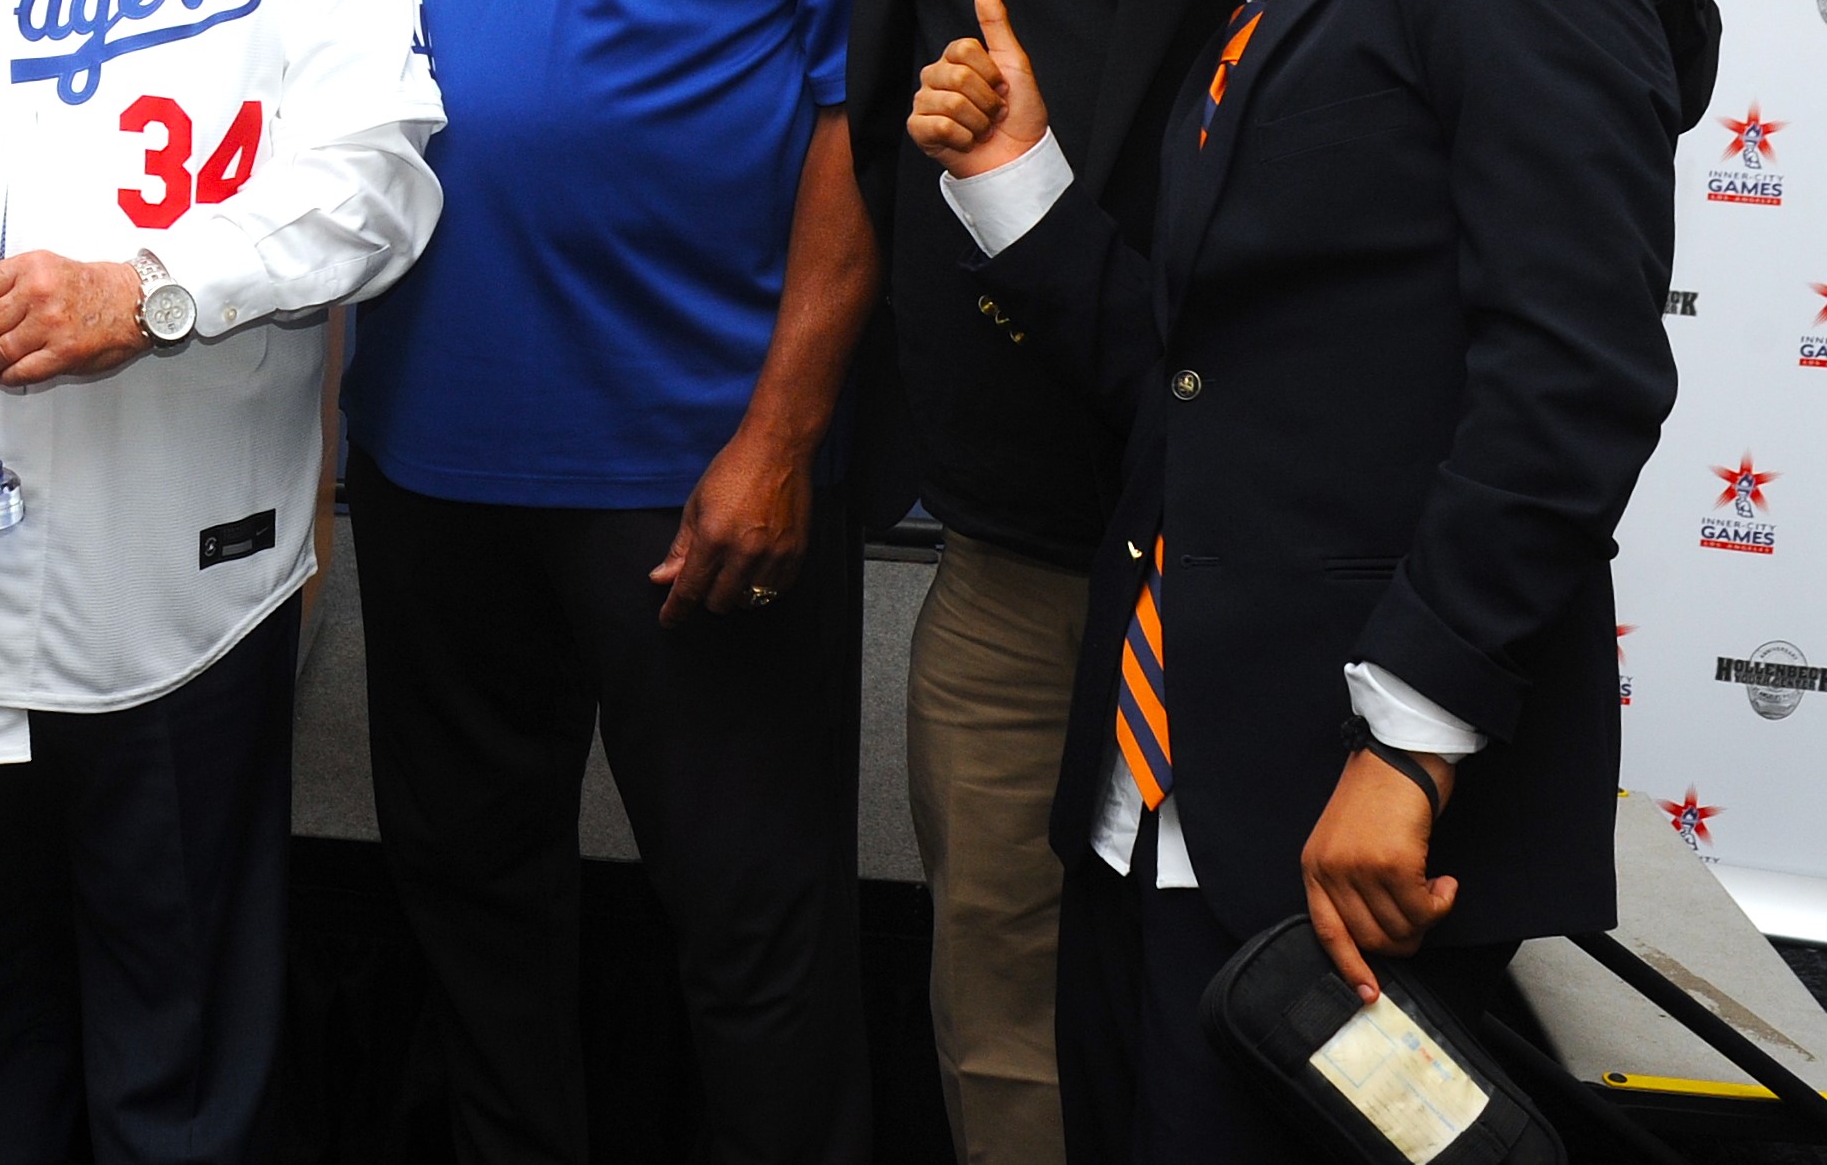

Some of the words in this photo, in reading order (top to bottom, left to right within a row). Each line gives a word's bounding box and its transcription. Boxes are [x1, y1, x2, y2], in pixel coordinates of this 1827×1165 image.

[118, 95, 263, 230] 34
[1709, 170, 1784, 181] INNER-CITY
[1708, 178, 1782, 197] GAMES
[1702, 517, 1776, 531] INNER-CITY
[1701, 525, 1775, 546] GAMES
